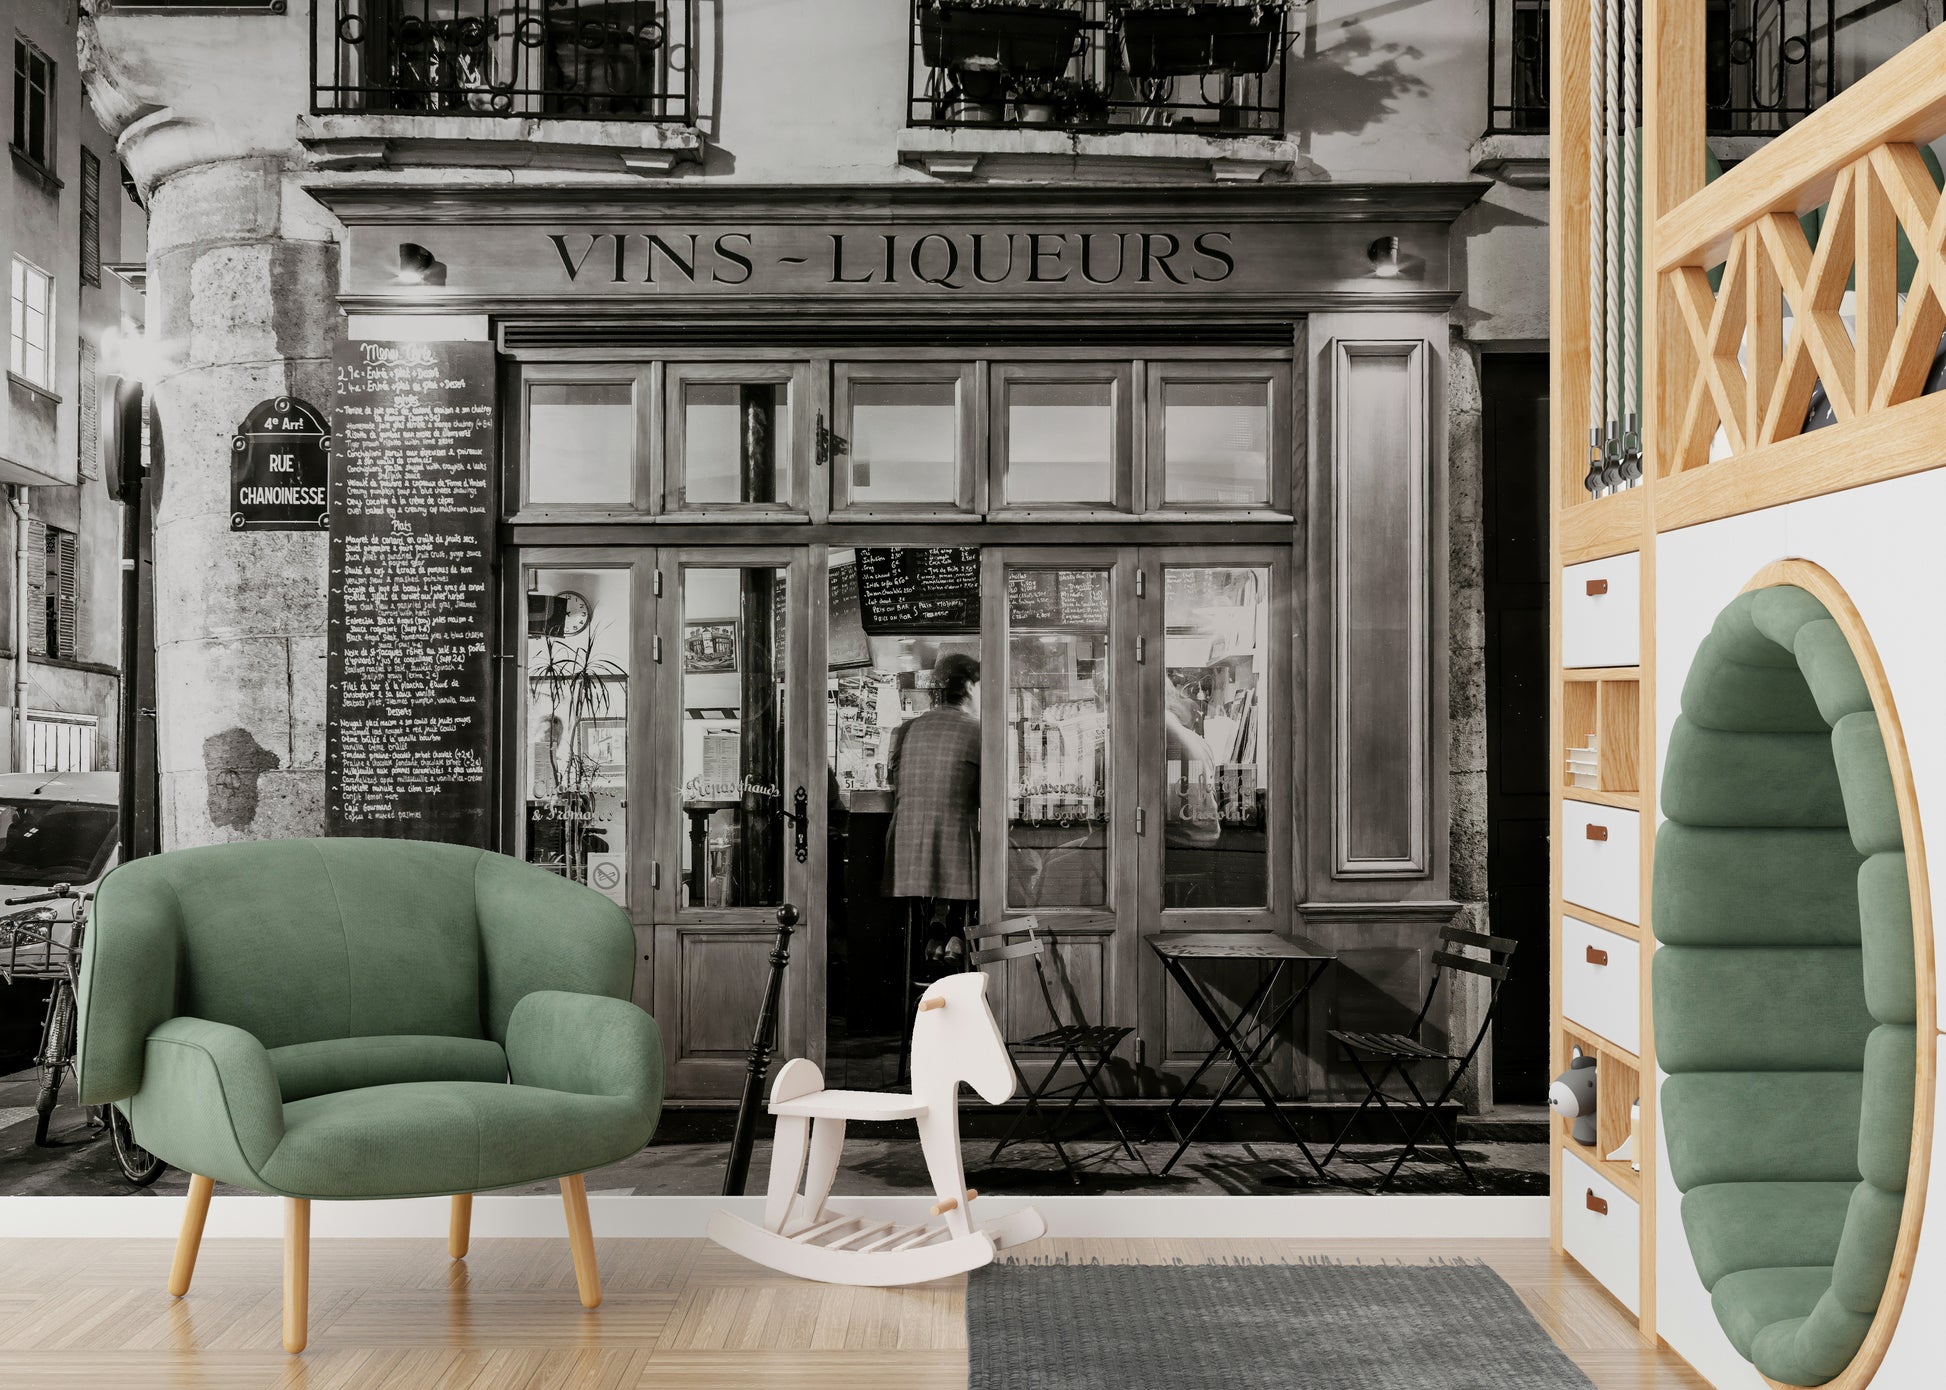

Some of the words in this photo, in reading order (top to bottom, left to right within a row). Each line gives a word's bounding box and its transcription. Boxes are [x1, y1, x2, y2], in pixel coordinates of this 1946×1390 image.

[547, 232, 754, 283] VINS
[828, 232, 1235, 289] LIQUEURS
[269, 454, 294, 472] RUE
[240, 487, 326, 505] CHANOINESSE
[391, 520, 412, 531] Plats
[845, 779, 854, 788] 51
